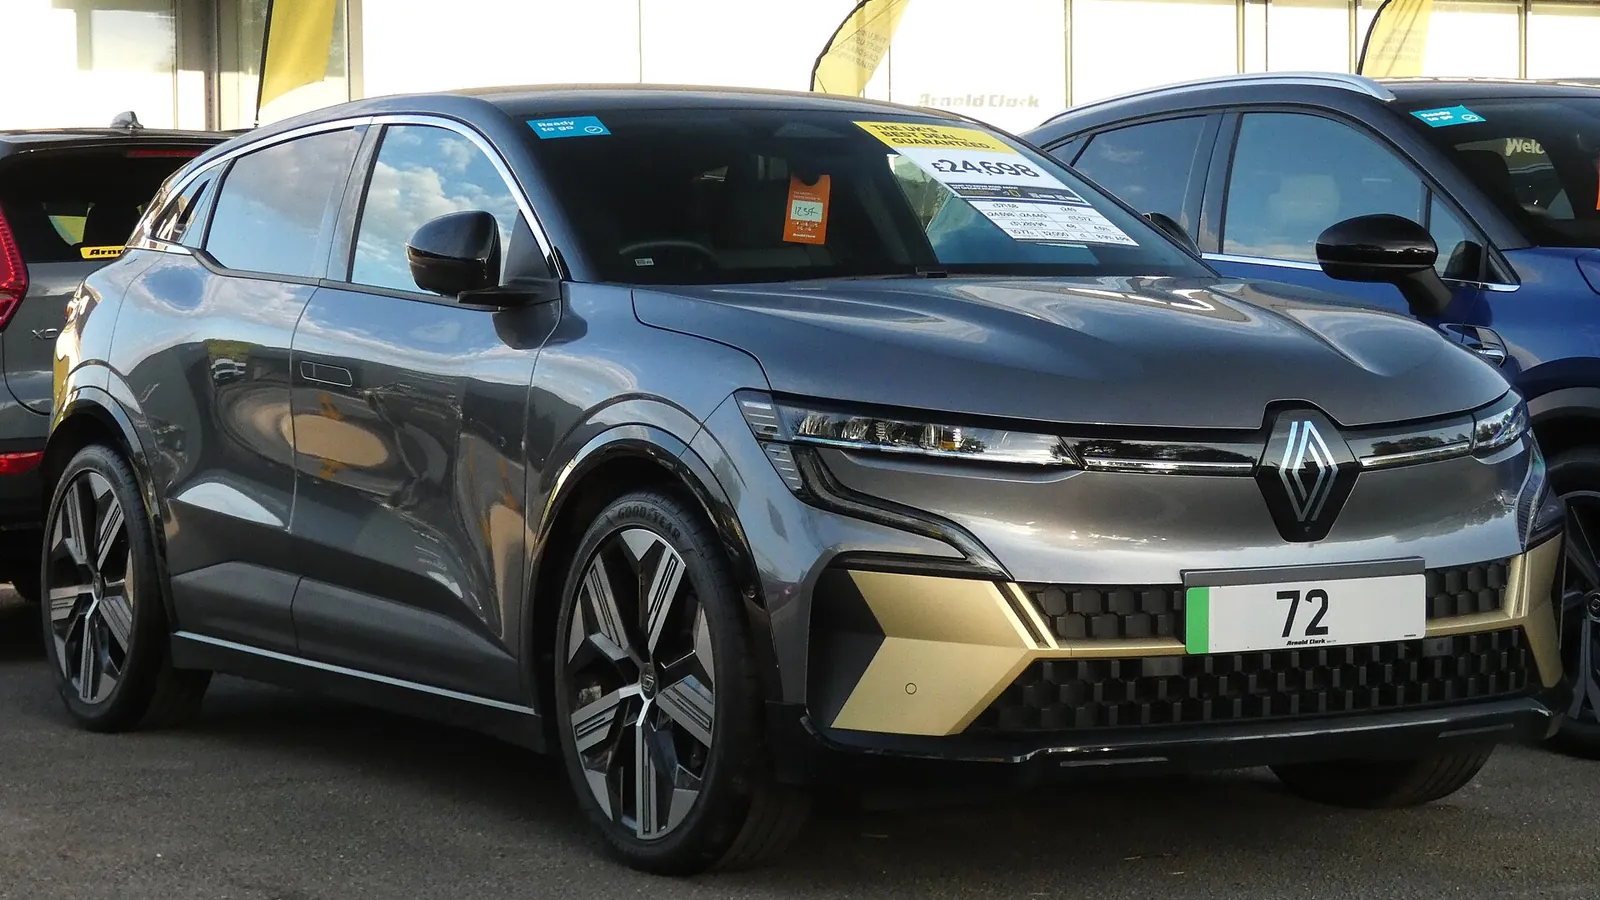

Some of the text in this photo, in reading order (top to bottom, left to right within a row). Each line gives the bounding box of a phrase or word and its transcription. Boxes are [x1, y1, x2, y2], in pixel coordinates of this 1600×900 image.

[918, 93, 1040, 108] Arnold Clark
[902, 125, 938, 133] UK'S
[931, 159, 1040, 178] £24,698
[1276, 588, 1329, 638] 72
